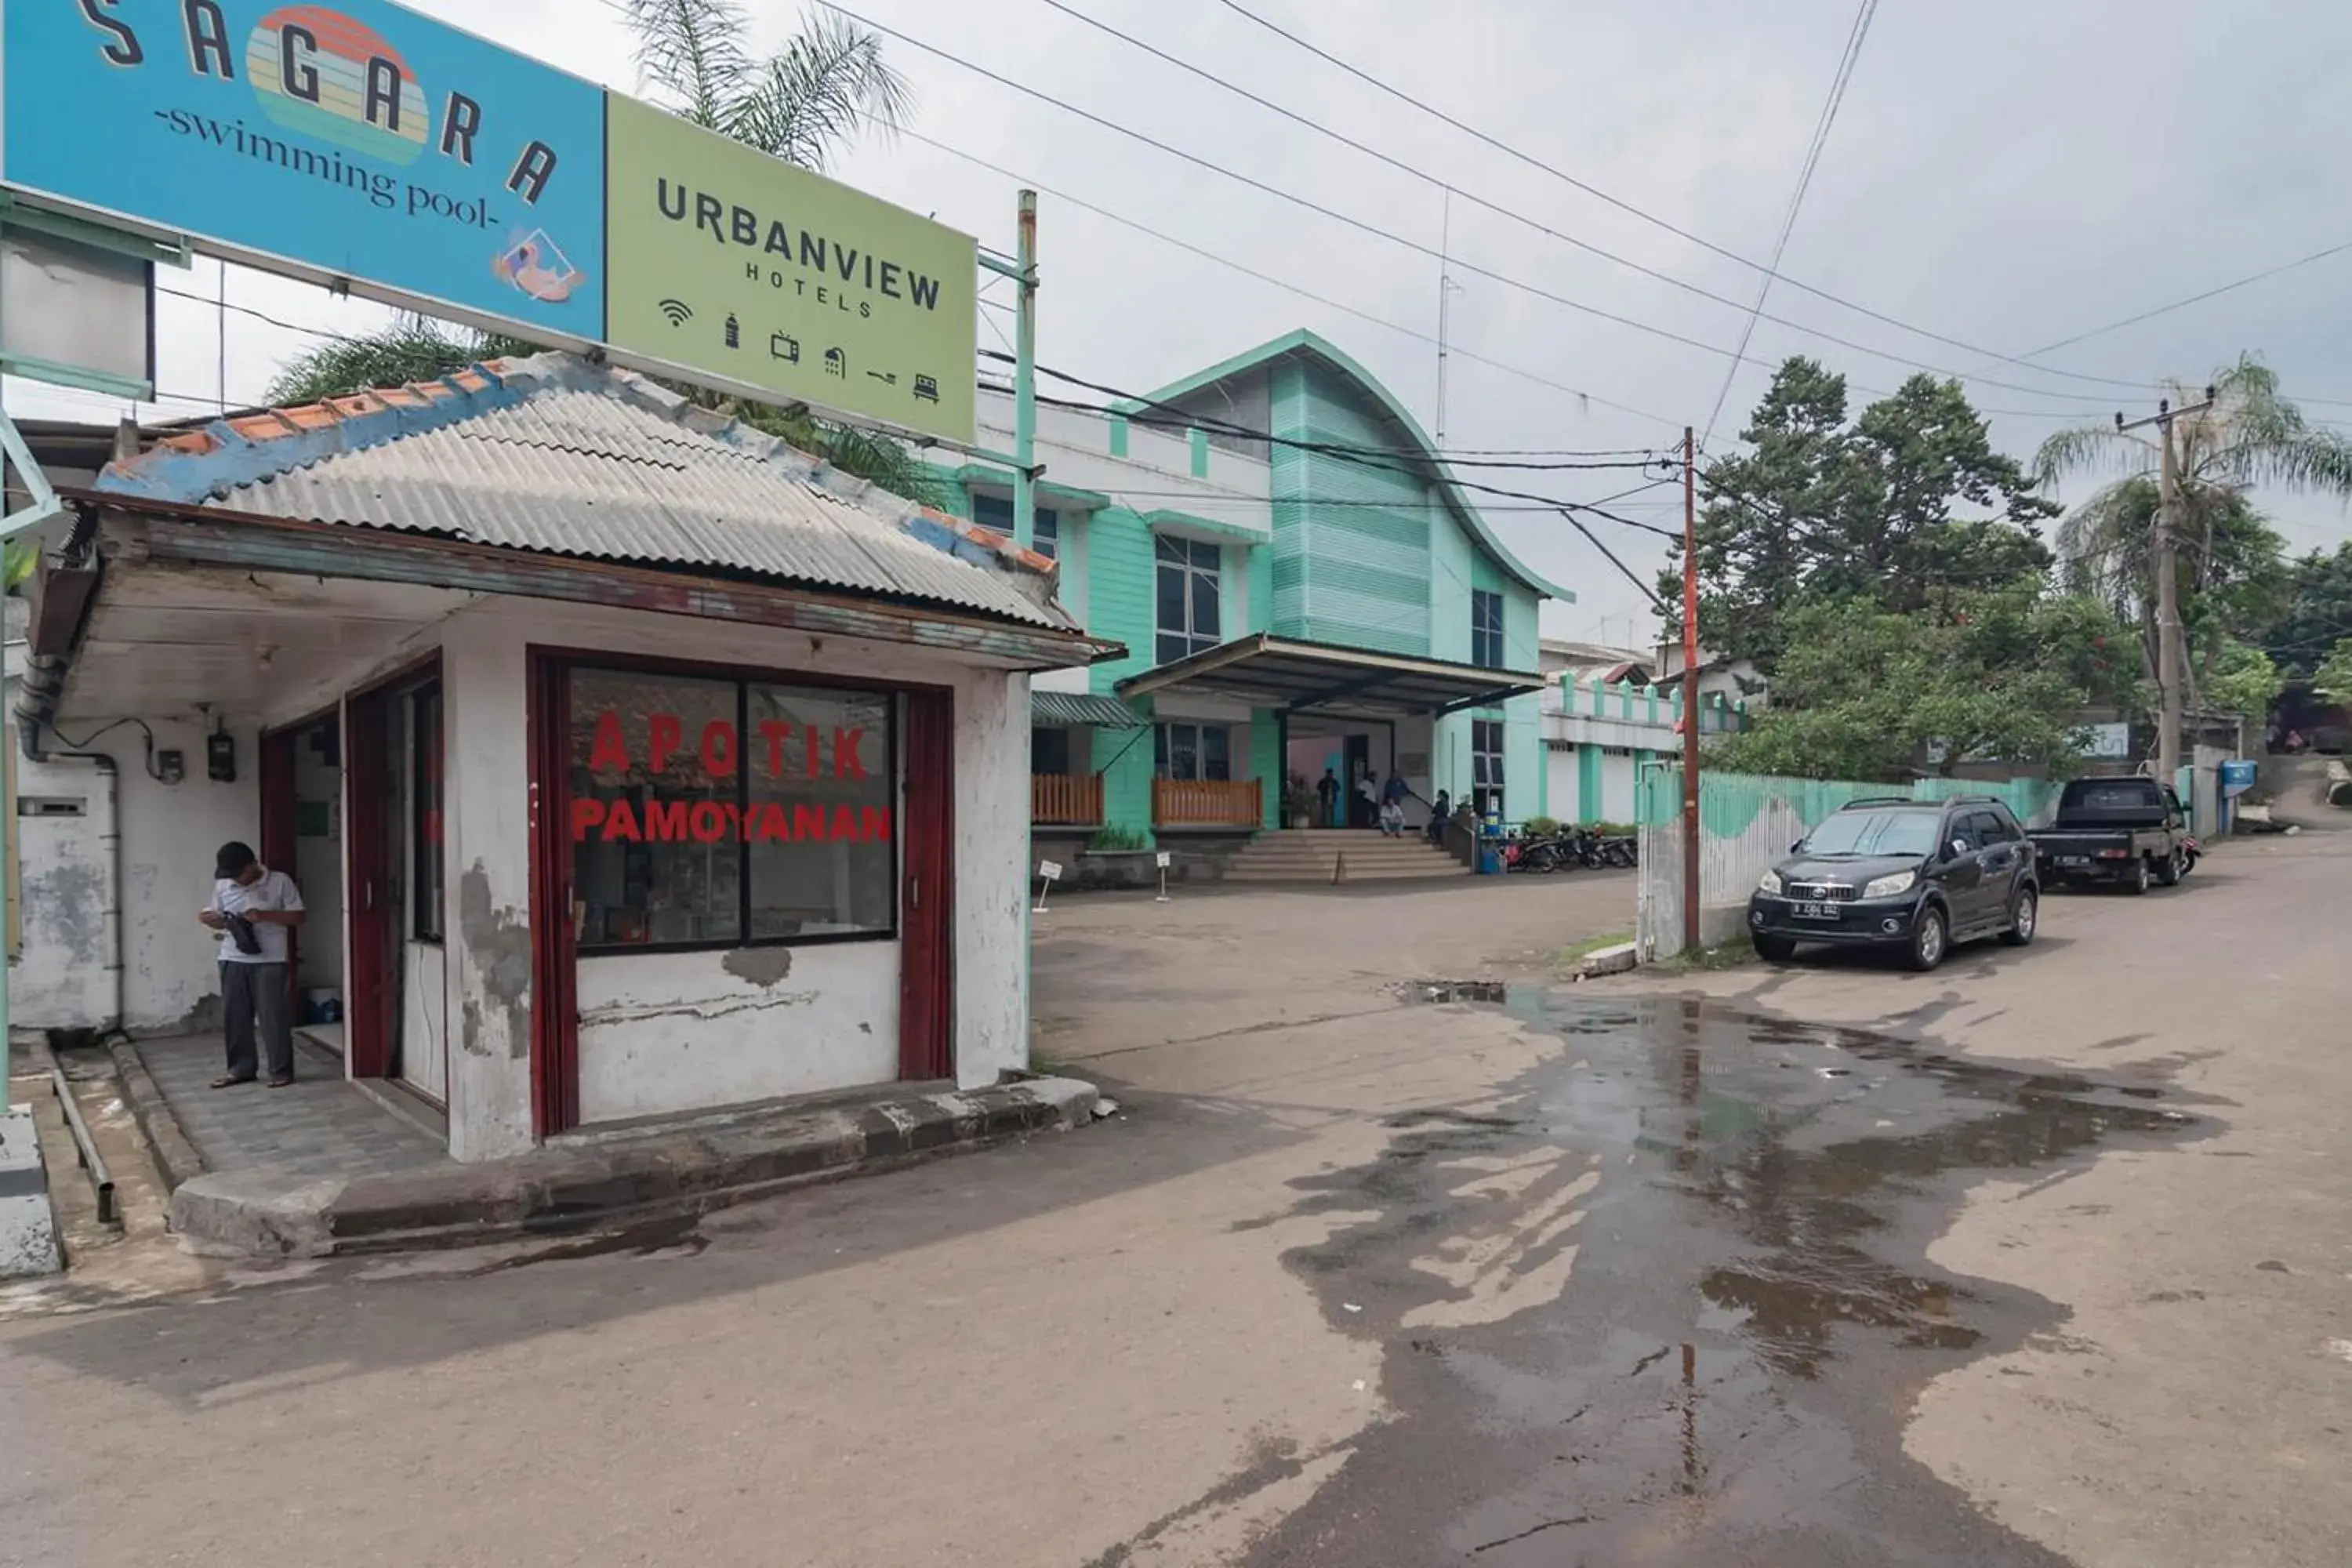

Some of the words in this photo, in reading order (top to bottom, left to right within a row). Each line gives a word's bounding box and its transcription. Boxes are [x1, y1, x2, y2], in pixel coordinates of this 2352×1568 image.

[78, 0, 557, 207] SAGARA
[657, 177, 940, 310] URBANVIEW
[746, 262, 871, 319] HOTELS
[590, 710, 866, 780] APOTIK
[571, 798, 891, 844] PAMOYANAN
